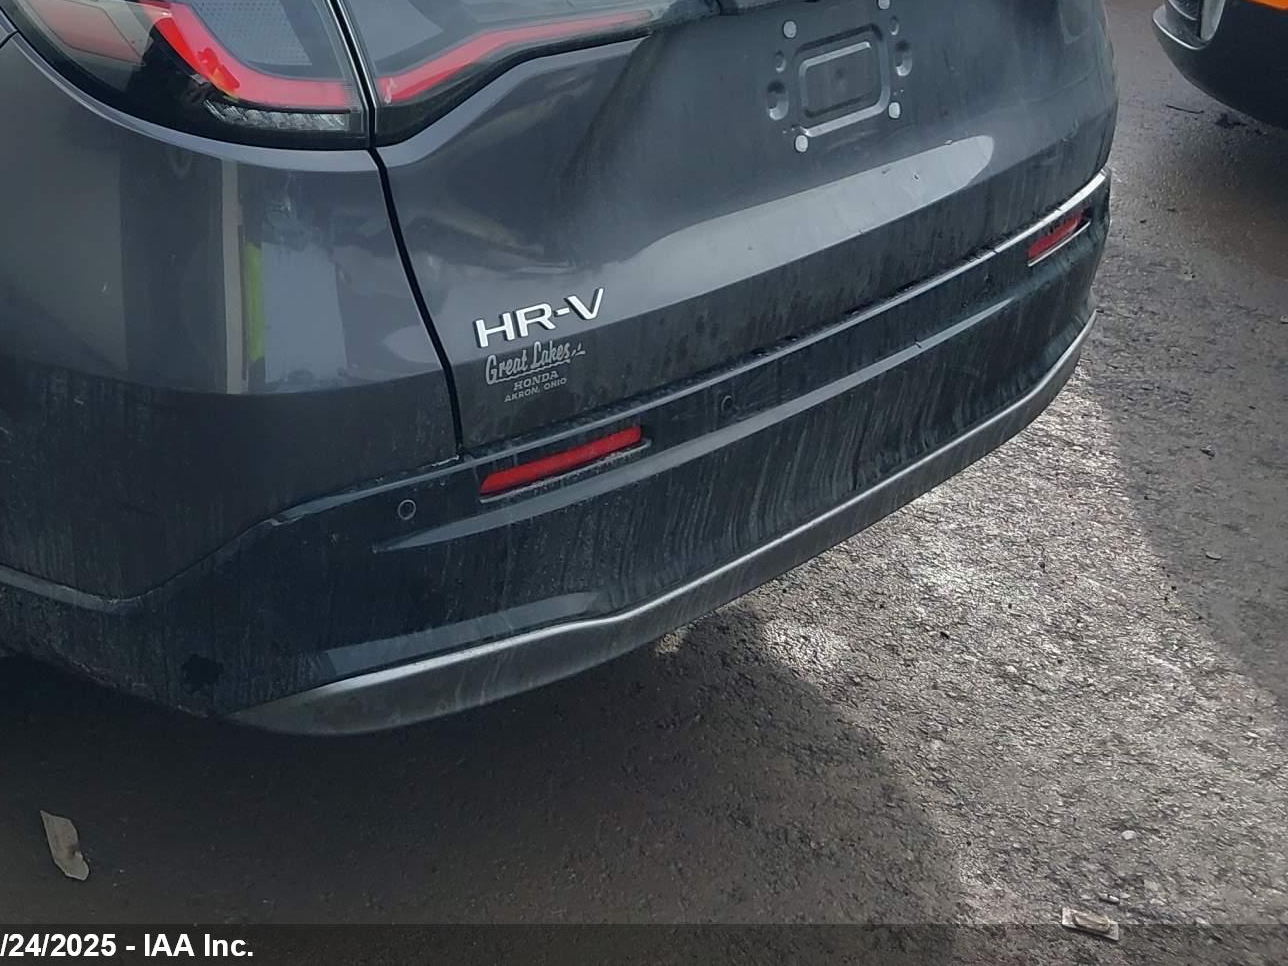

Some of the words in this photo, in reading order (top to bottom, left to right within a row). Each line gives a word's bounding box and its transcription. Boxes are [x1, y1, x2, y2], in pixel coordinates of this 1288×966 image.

[474, 288, 604, 348] HR-V
[485, 349, 528, 385] Great
[531, 341, 571, 369] Lakes
[513, 370, 559, 391] HONDA
[543, 378, 567, 390] OHIO
